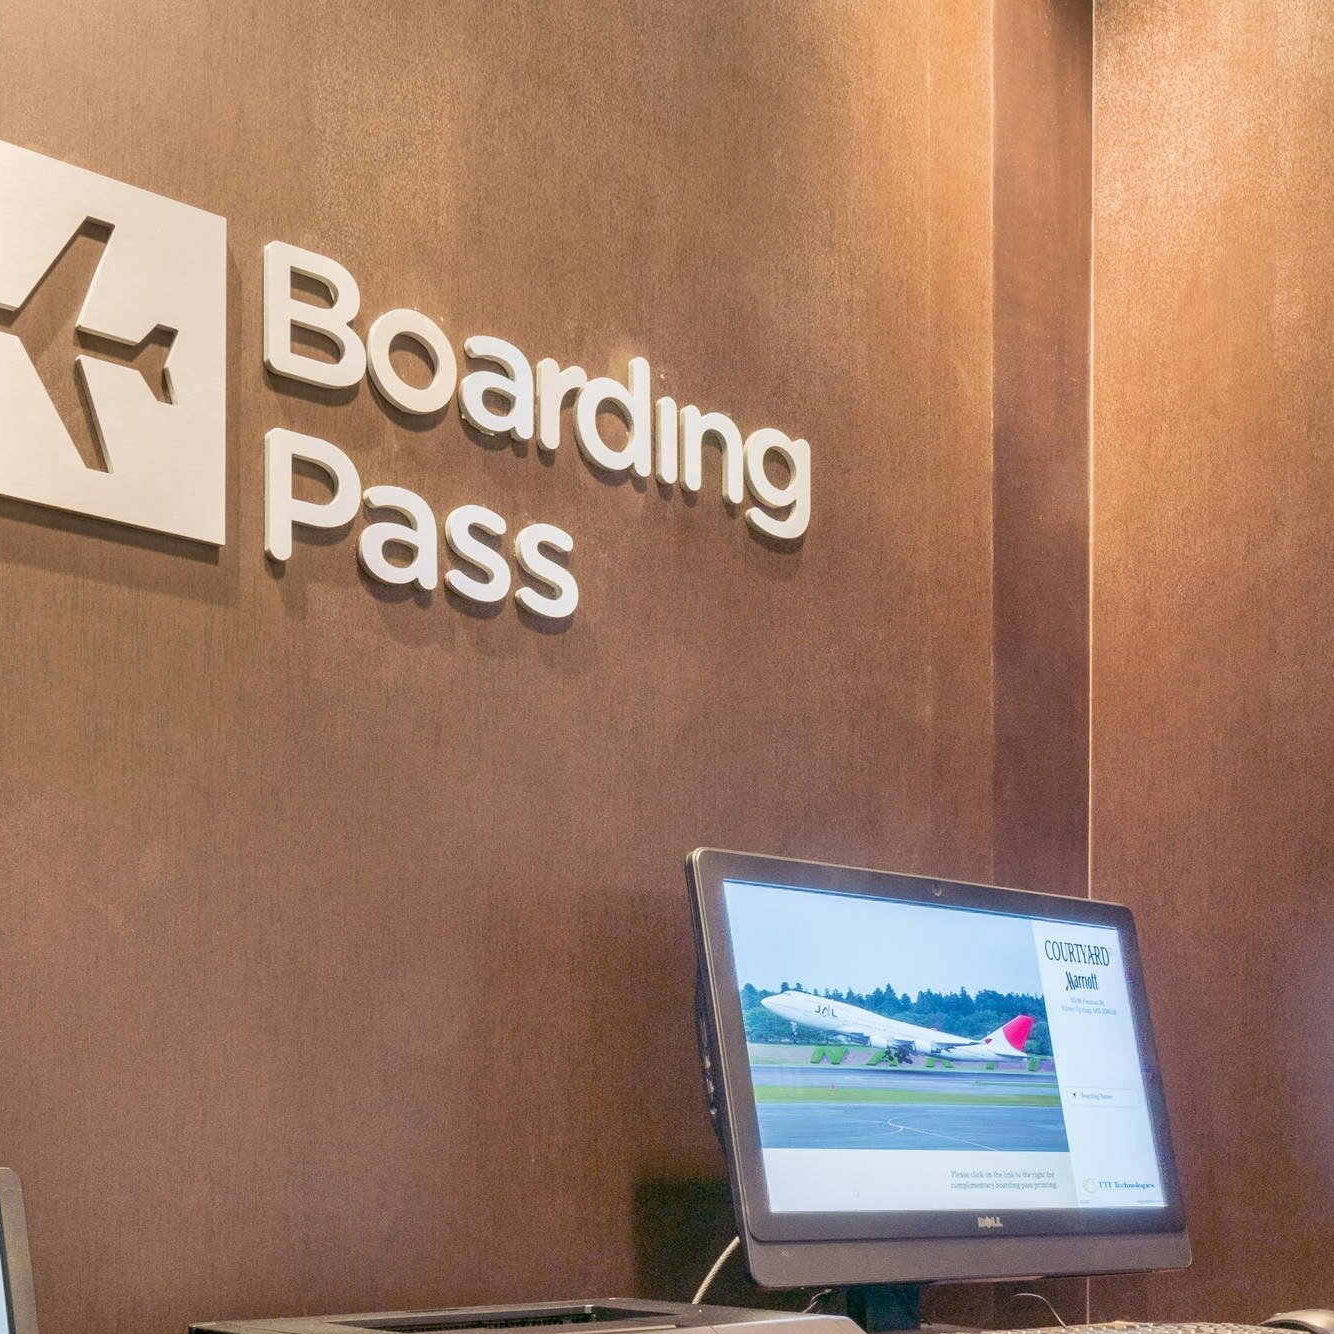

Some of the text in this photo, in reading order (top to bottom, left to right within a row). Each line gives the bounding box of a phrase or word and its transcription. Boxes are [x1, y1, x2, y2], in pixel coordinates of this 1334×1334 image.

[264, 239, 811, 540] Boarding
[264, 427, 580, 619] Pass
[1065, 971, 1099, 991] Marriott
[814, 1004, 838, 1018] JAL
[977, 1216, 1003, 1228] DELL
